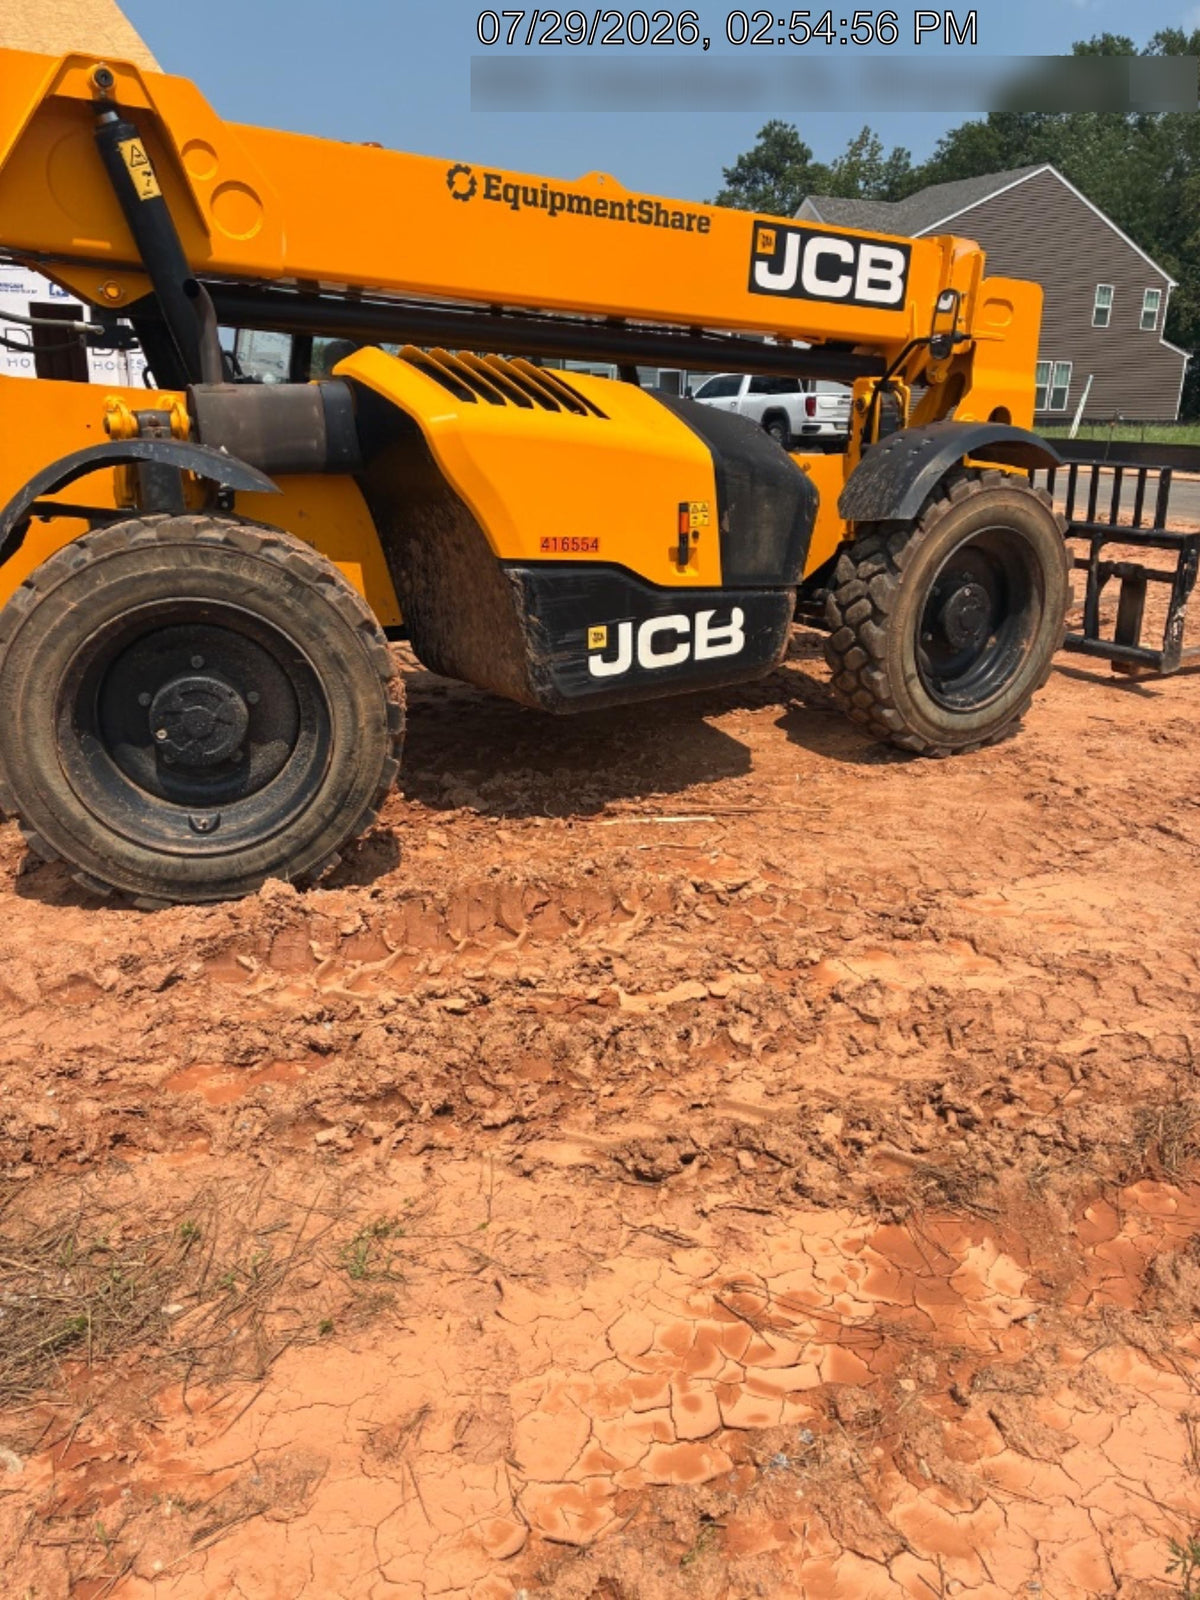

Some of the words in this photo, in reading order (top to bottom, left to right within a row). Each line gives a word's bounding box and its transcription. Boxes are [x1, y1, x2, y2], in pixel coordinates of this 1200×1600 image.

[483, 172, 711, 234] EquipmentShare
[754, 232, 906, 304] JCB
[540, 536, 599, 551] 416554
[588, 607, 745, 677] JCB
